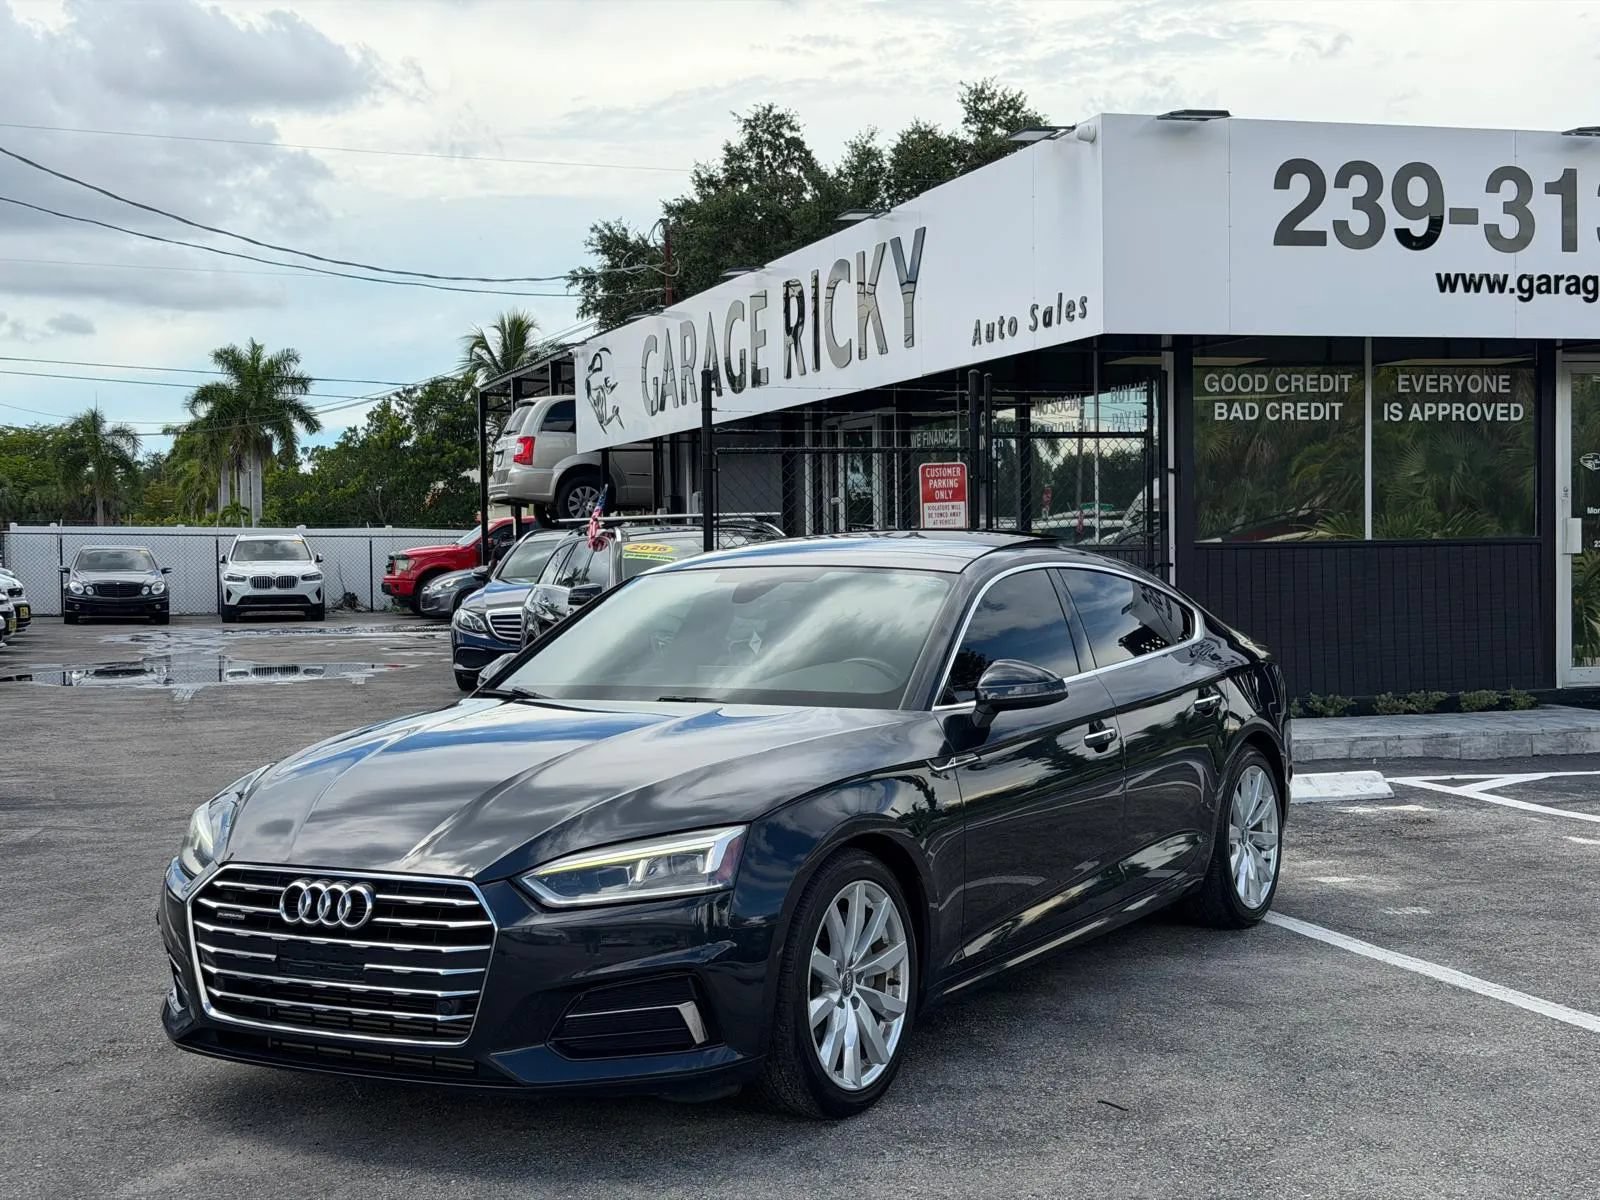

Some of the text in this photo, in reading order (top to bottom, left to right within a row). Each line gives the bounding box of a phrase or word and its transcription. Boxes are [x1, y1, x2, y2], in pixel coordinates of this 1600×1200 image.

[1273, 157, 1600, 253] 239-31
[1435, 272, 1599, 303] www.garag
[641, 226, 926, 416] GARAGE RICKY
[972, 292, 1088, 346] Auto Sales
[1204, 373, 1352, 393] GOOD CREDIT
[1397, 374, 1511, 393] EVERYONE
[1049, 392, 1084, 415] SOCIAL
[1214, 402, 1343, 421] BAD CREDIT
[1383, 402, 1524, 421] IS APPROVED
[911, 432, 921, 448] WE
[926, 467, 961, 478] CUSTOMER
[929, 478, 959, 489] PARKING
[935, 489, 953, 500] ONLY
[630, 544, 667, 552] 2016
